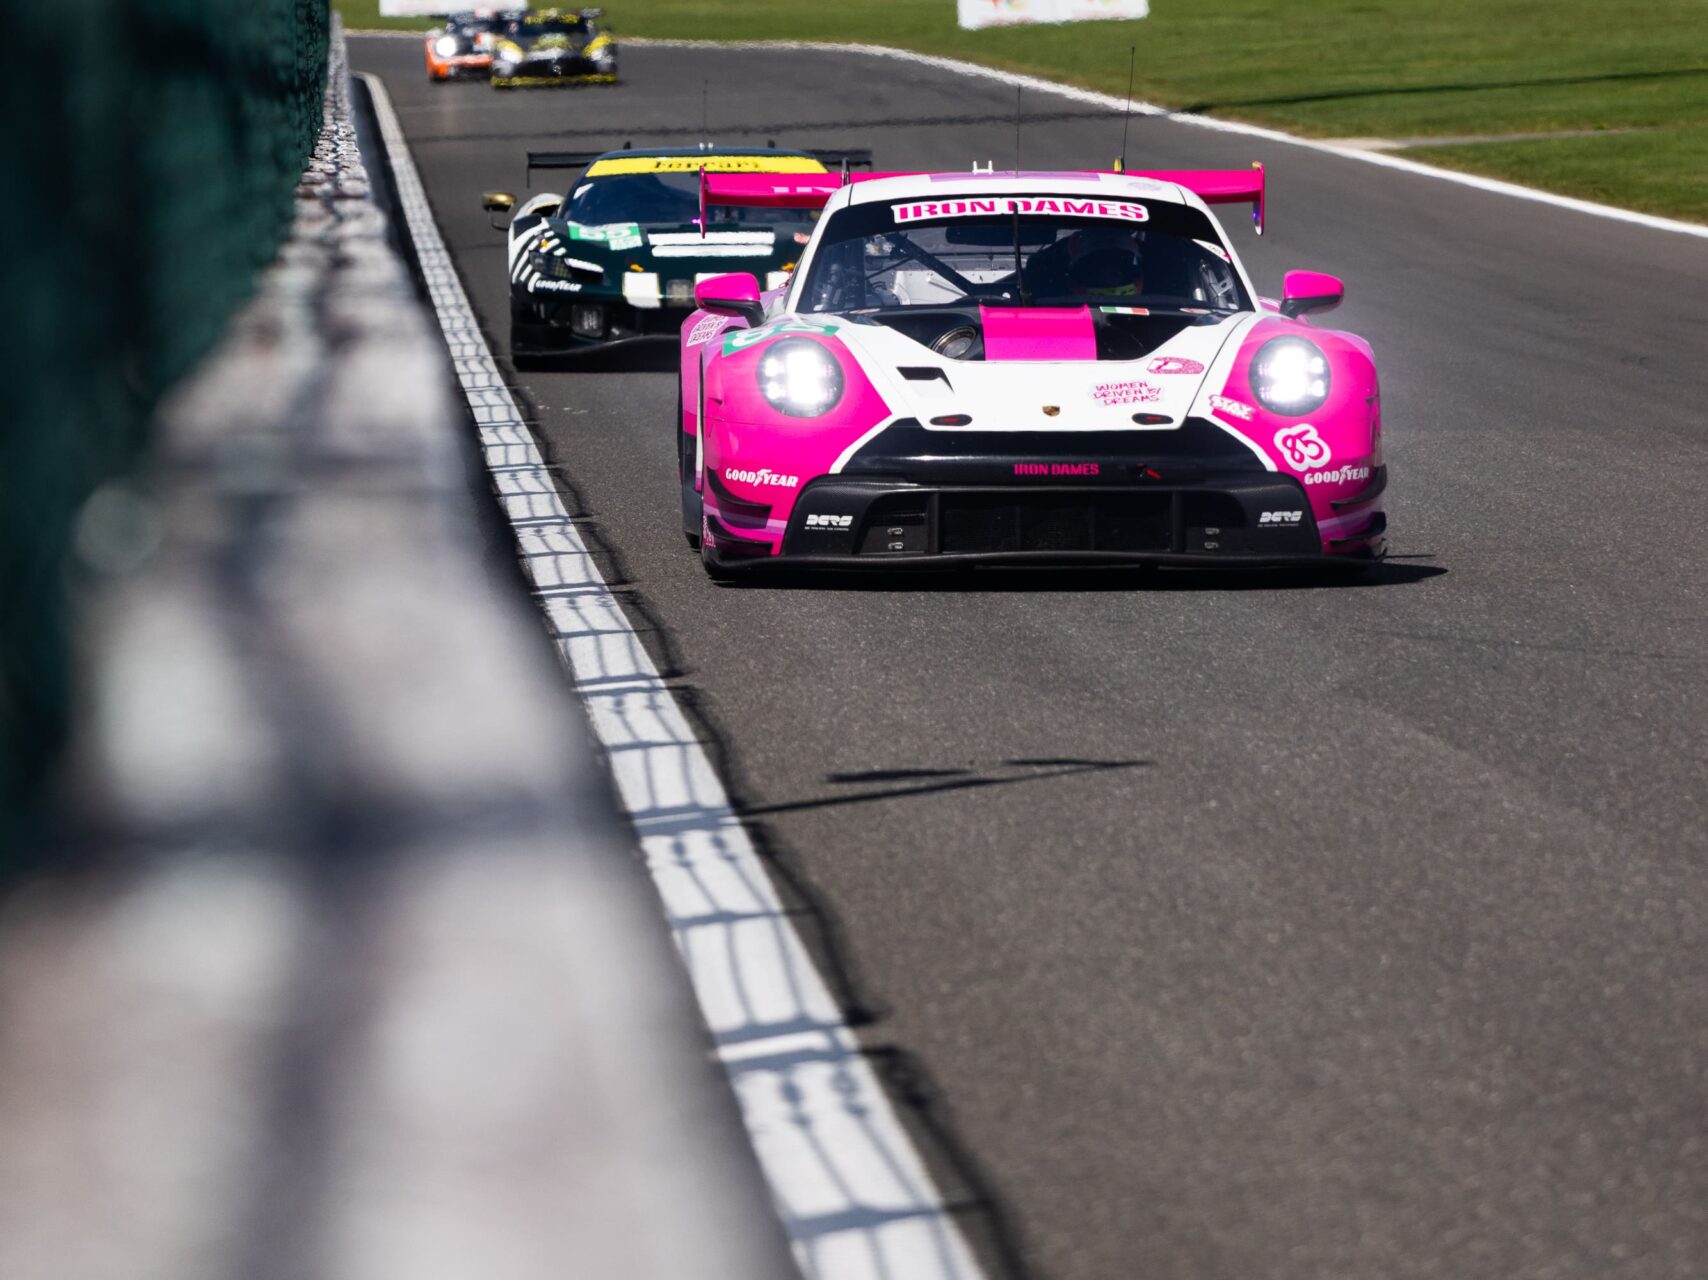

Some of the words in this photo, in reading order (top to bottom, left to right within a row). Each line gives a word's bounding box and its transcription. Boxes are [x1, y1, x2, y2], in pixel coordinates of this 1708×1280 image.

[898, 200, 996, 220] IRON
[1007, 200, 1146, 220] DAMES
[1093, 388, 1143, 399] DRIVEN
[1095, 381, 1149, 392] WOMEN
[1103, 394, 1160, 406] DREAMS
[1281, 428, 1325, 464] 85
[725, 467, 799, 488] GOODYEAR
[1013, 463, 1049, 476] IRON
[1051, 463, 1100, 476] DAMES
[1303, 465, 1370, 486] GOODYEAR
